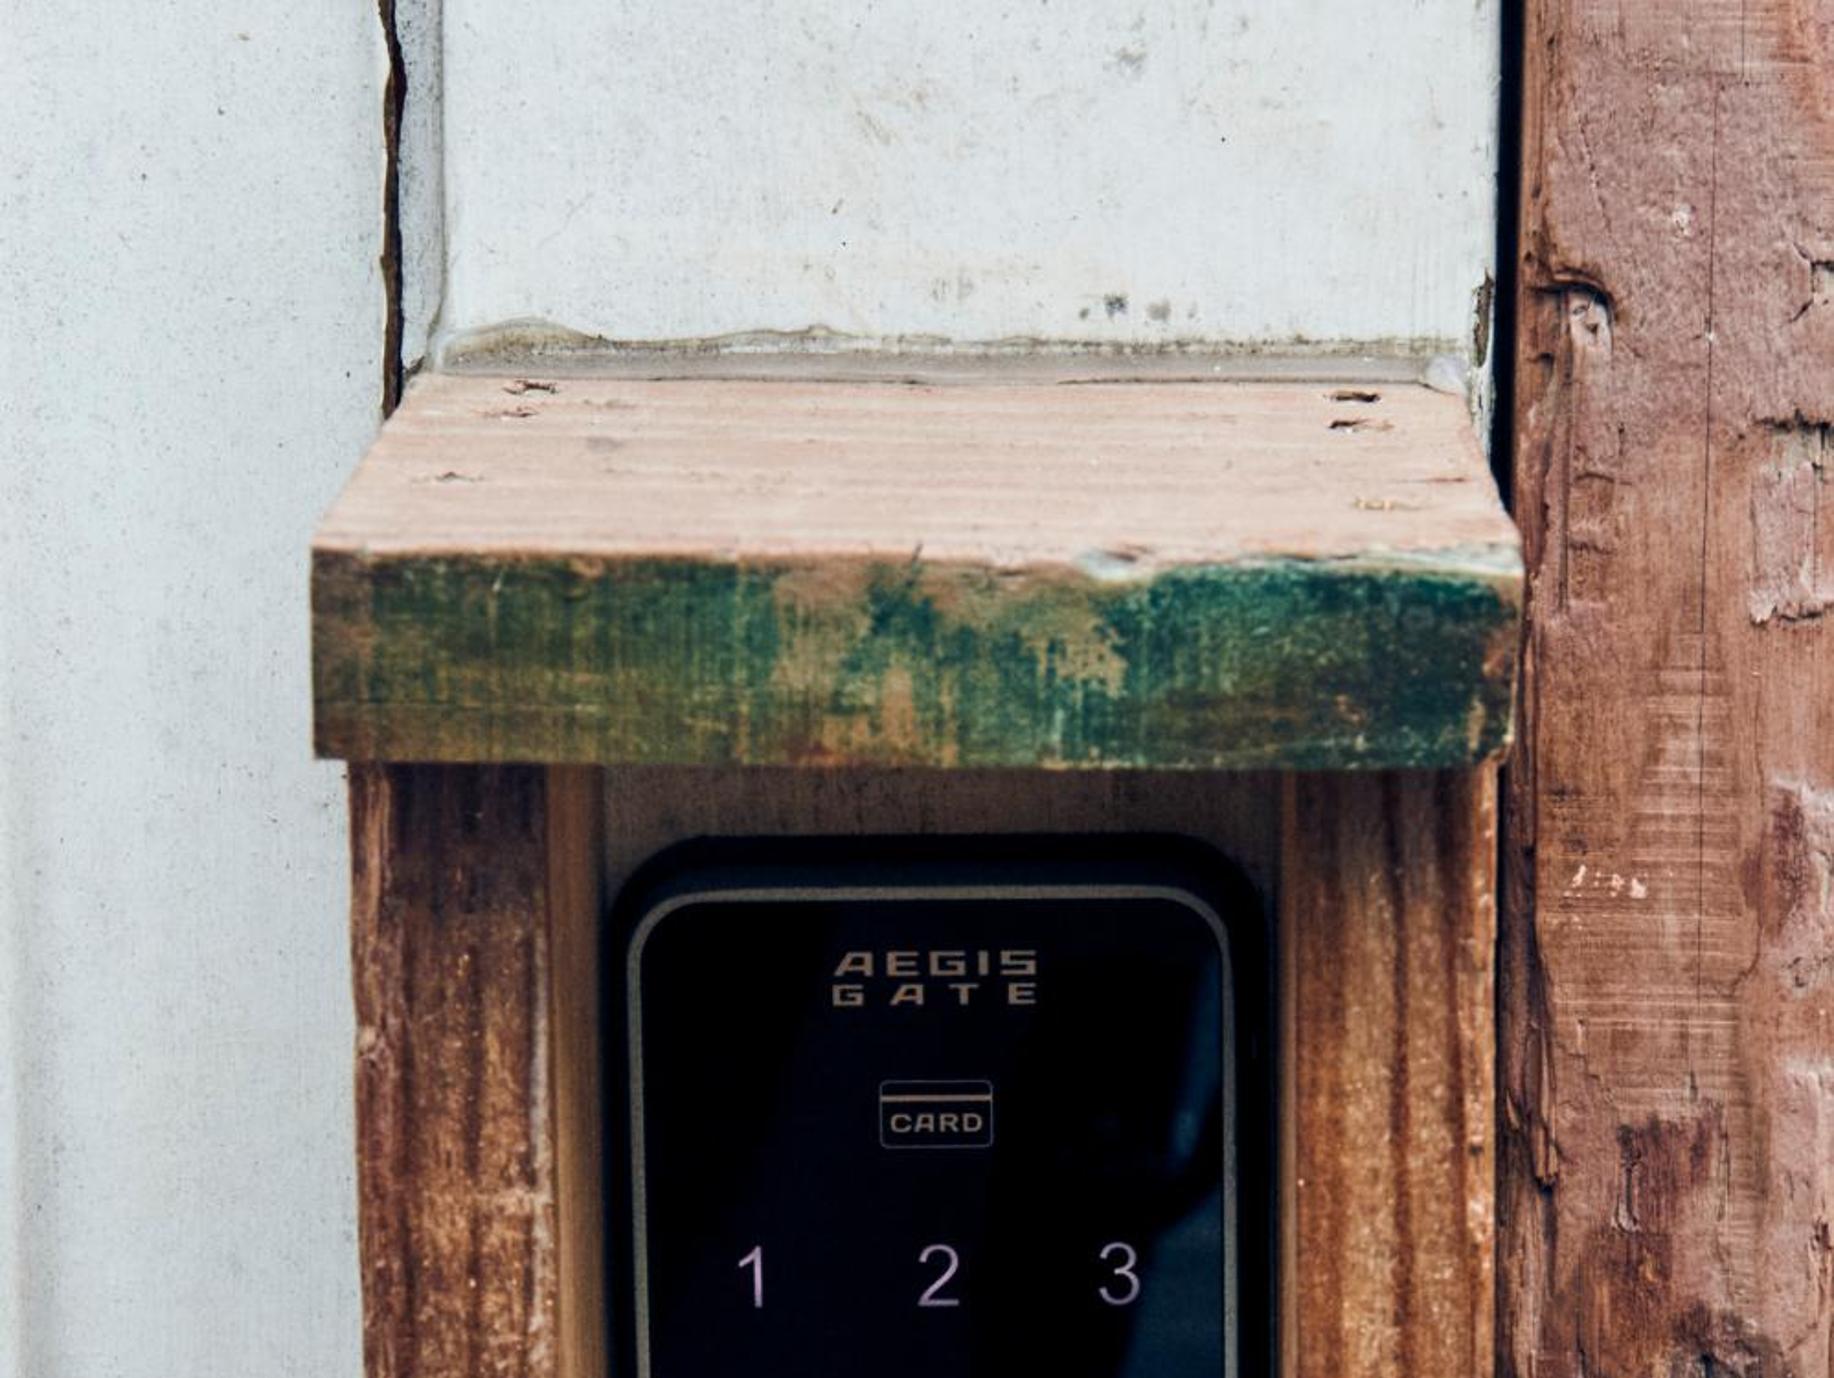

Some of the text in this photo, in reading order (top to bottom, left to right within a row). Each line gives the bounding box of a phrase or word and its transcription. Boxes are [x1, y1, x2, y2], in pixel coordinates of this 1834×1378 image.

[833, 949, 1038, 977] AEGIS
[832, 983, 1038, 1006] GATE
[889, 1112, 983, 1133] CARD
[738, 1243, 1140, 1307] 1 2 3
